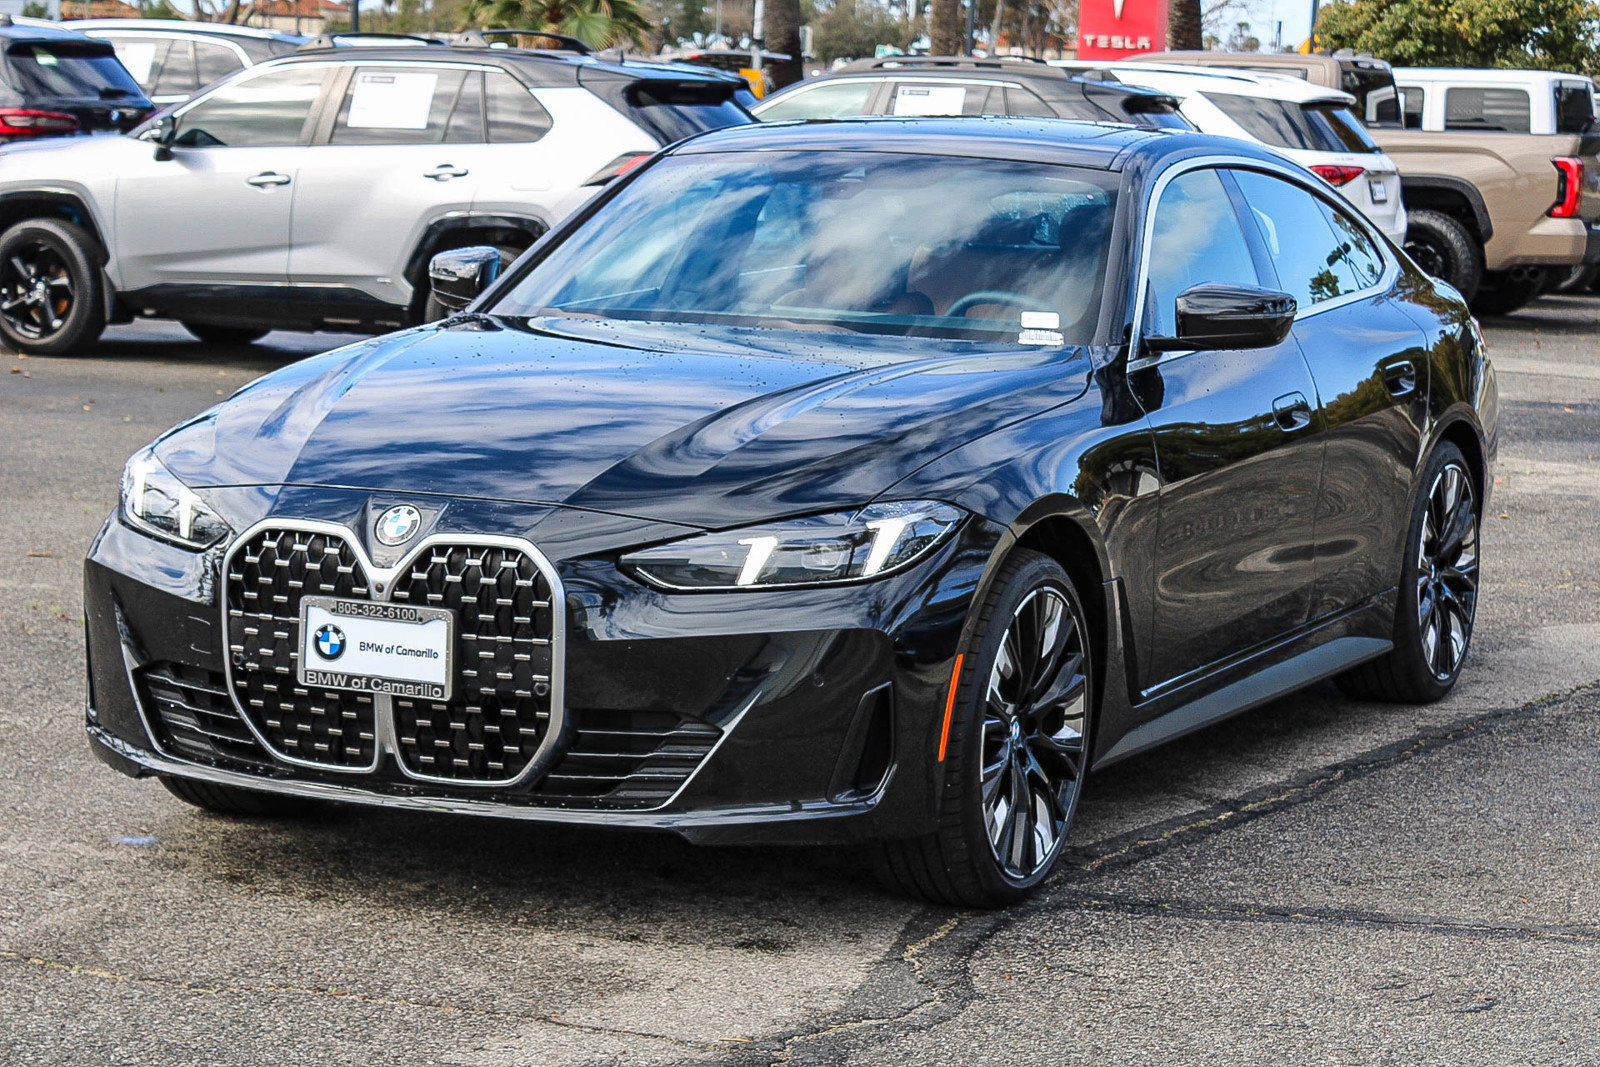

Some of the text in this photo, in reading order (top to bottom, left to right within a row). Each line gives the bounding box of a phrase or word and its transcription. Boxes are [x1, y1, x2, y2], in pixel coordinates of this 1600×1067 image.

[1082, 34, 1151, 50] TESLA
[337, 602, 416, 621] 805-322-6100
[359, 641, 439, 659] BMW of Camarillo
[306, 671, 442, 698] BMW of Camarillo
